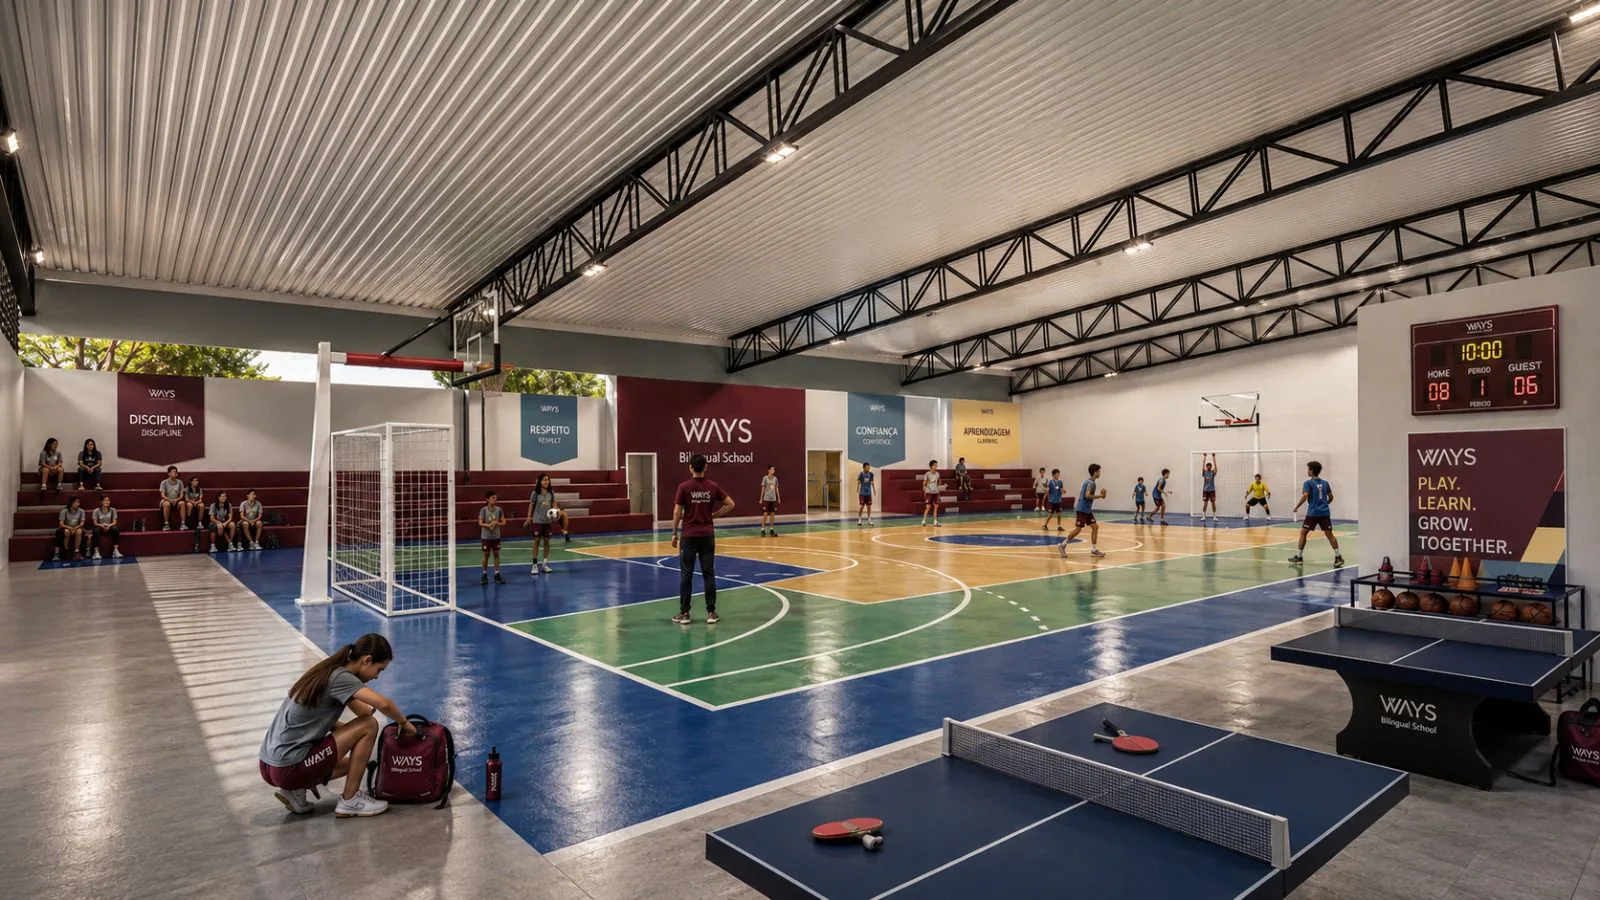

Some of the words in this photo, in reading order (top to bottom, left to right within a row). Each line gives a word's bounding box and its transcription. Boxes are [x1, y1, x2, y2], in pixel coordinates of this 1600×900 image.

[1466, 319, 1493, 331] WAYS
[1461, 340, 1502, 361] 10:00
[1508, 361, 1542, 373] GUEST
[1427, 369, 1451, 379] HOME
[1514, 375, 1538, 395] 06
[148, 388, 176, 398] WAYS
[1428, 382, 1450, 401] 08
[129, 414, 194, 426] DISCIPLINA
[141, 429, 182, 437] DISCIPLINE
[530, 425, 570, 435] RESPEITO
[678, 416, 752, 443] WAYS
[855, 426, 898, 438] CONFIANÇA
[963, 427, 1011, 437] APRENDIZAGEM
[679, 451, 720, 463] Bilual
[722, 451, 753, 463] School
[1417, 448, 1477, 466] WAYS
[1418, 476, 1460, 491] PLAY.
[1418, 496, 1476, 511] LEARN.
[1418, 516, 1473, 531] GROW.
[1418, 536, 1513, 555] TOGETHER.
[1380, 694, 1437, 721] WAYS
[1412, 722, 1437, 734] School
[1571, 745, 1600, 760] WAYS
[391, 755, 422, 766] WAYS
